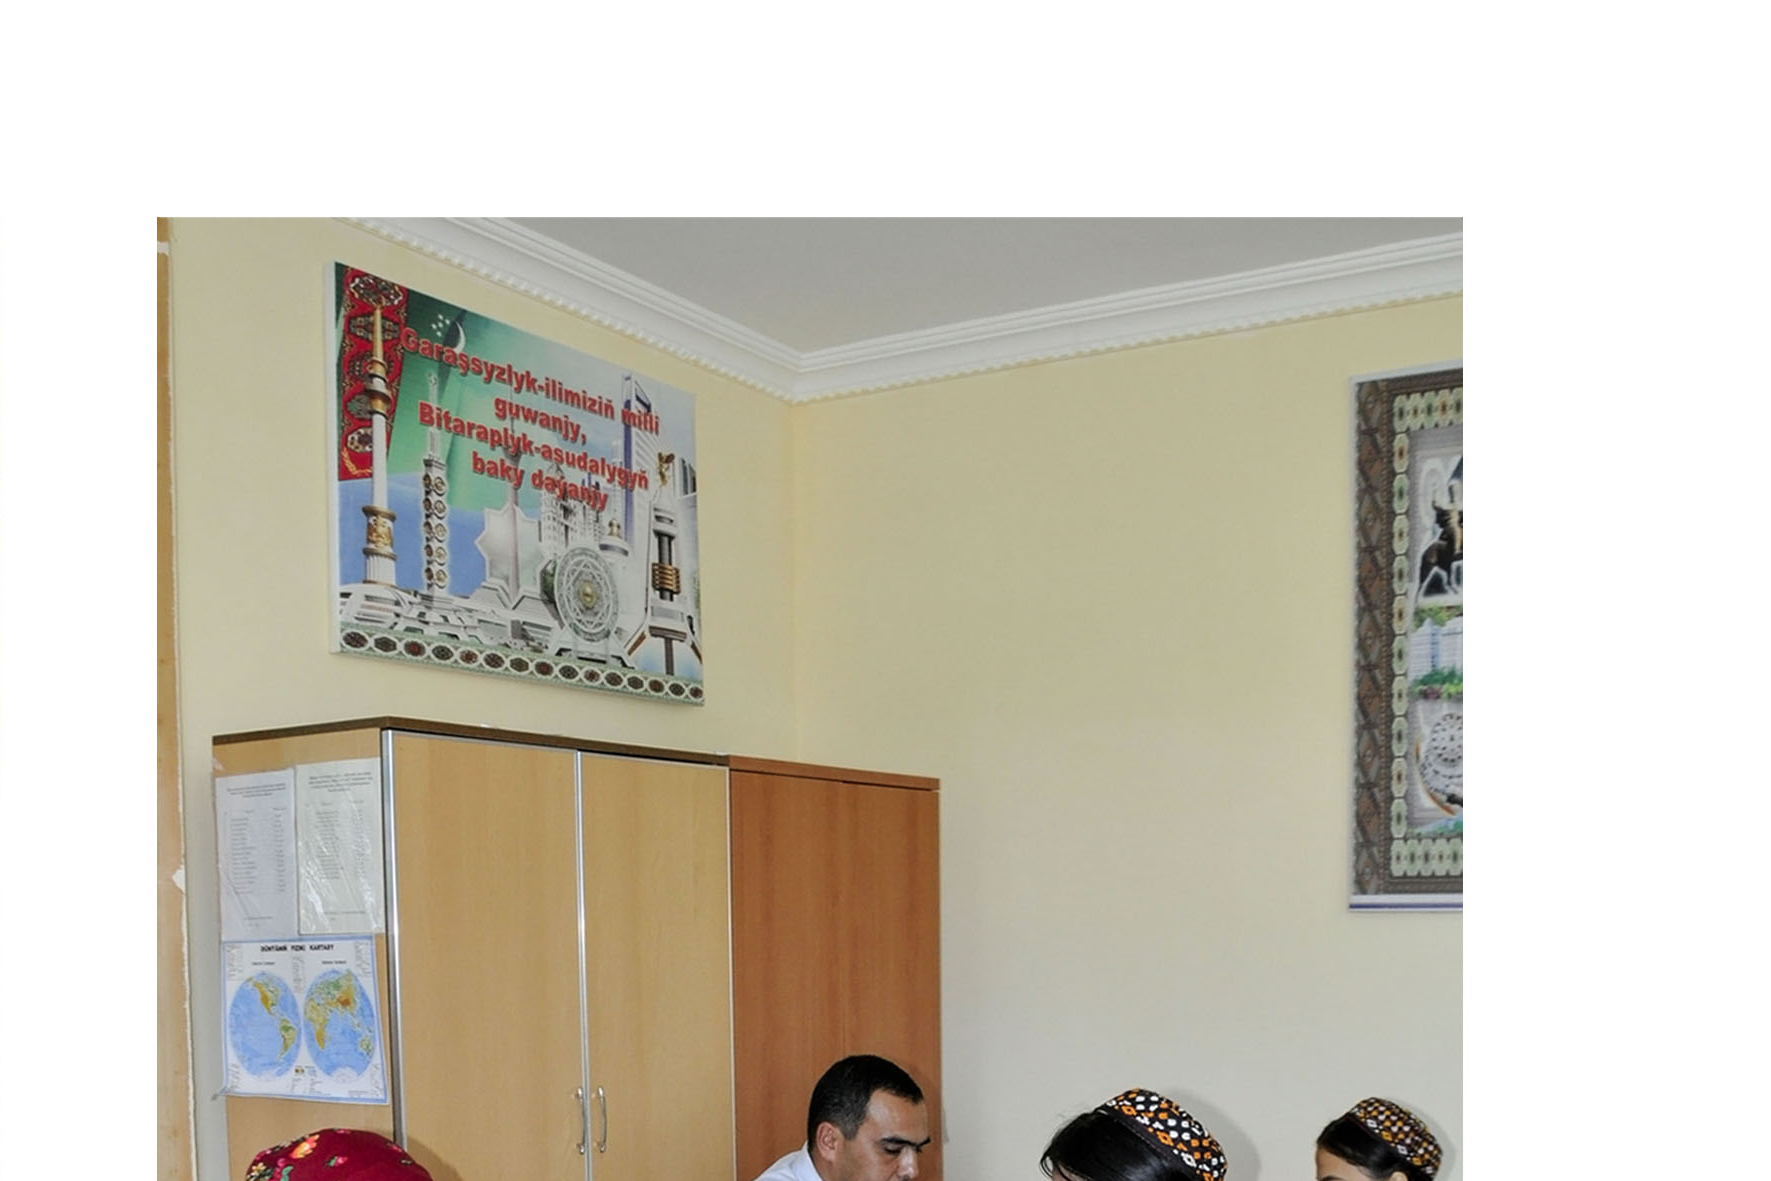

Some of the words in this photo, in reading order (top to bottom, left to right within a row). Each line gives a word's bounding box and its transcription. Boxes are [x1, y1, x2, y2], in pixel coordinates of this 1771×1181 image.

[400, 327, 615, 420] Garaşsyzlyk-ilimiziň
[621, 408, 659, 436] milli
[419, 401, 649, 492] Bitaraplyk-asudalygyň
[494, 397, 586, 446] guwanjy,
[472, 450, 525, 490] baky
[531, 469, 609, 512] daýanjy
